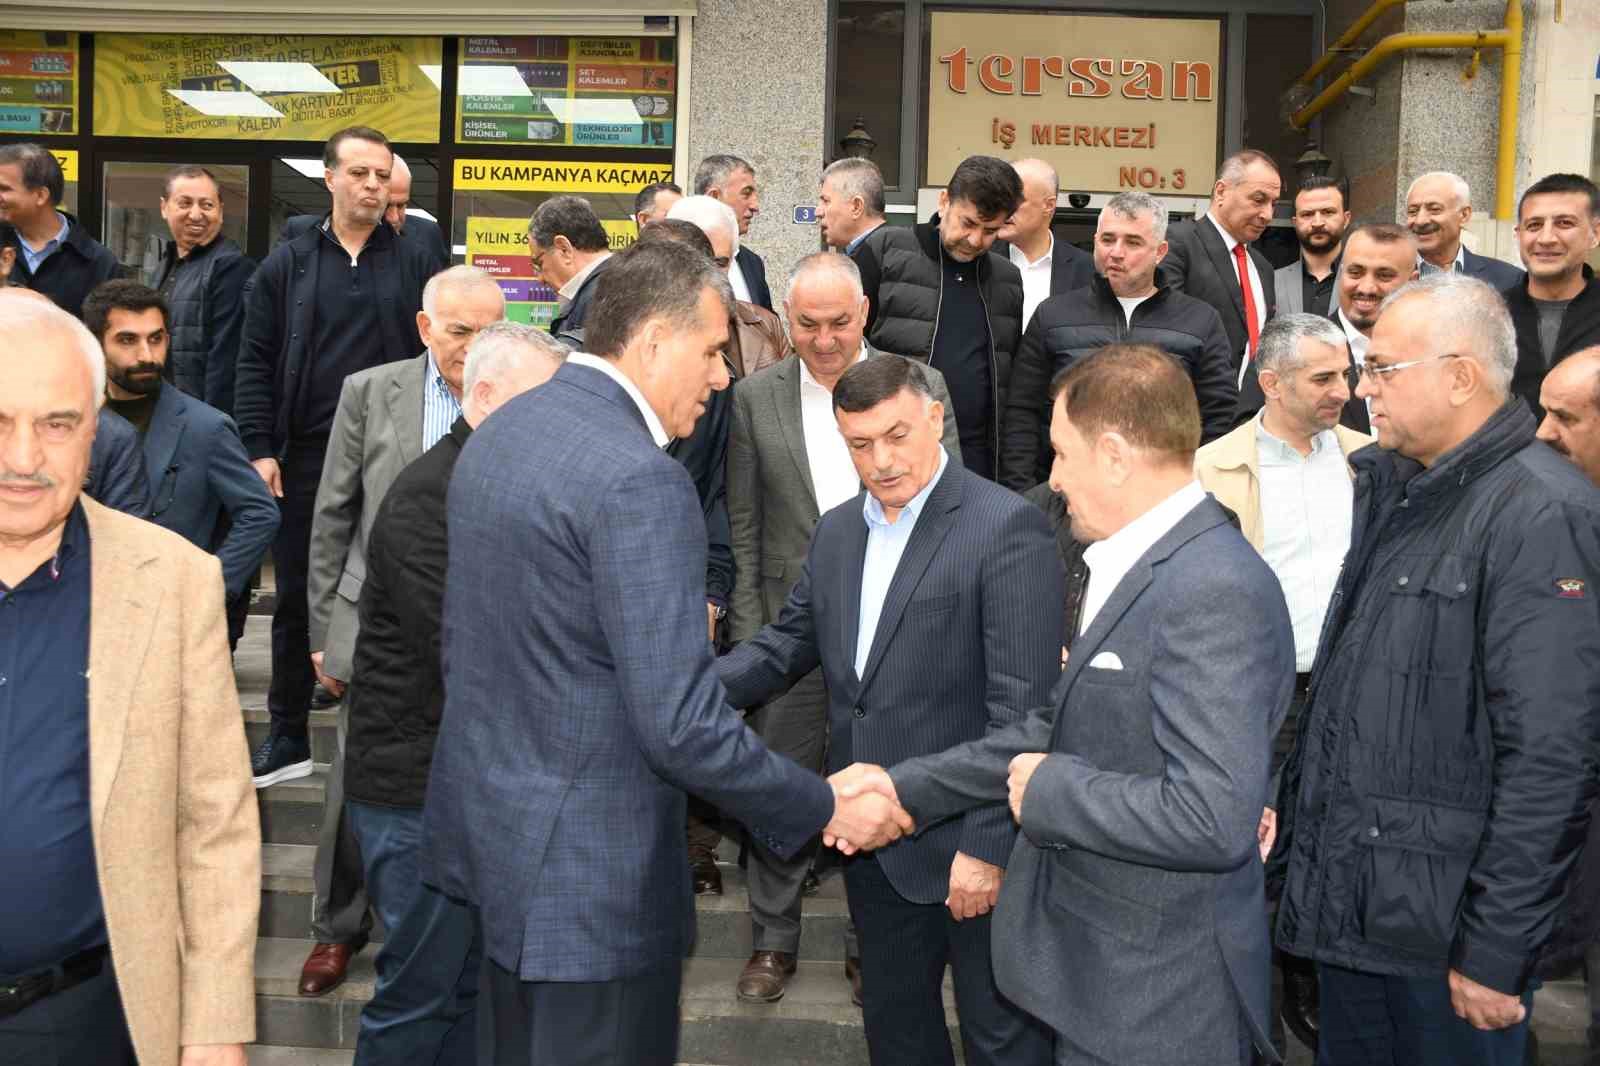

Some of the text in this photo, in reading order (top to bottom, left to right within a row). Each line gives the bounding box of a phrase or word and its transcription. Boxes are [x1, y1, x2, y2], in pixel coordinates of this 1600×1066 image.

[939, 47, 1213, 101] tersan
[465, 120, 497, 130] KİŞİSEL
[464, 128, 508, 138] ÜRÜNLER
[577, 131, 620, 141] ÜRÜNLER
[991, 117, 1156, 150] İŞ MERKEZİ
[462, 166, 672, 187] BU KAMPANYA KAÇMAZ
[802, 208, 809, 220] 3
[475, 232, 509, 245] YILIN
[475, 258, 498, 267] METAL
